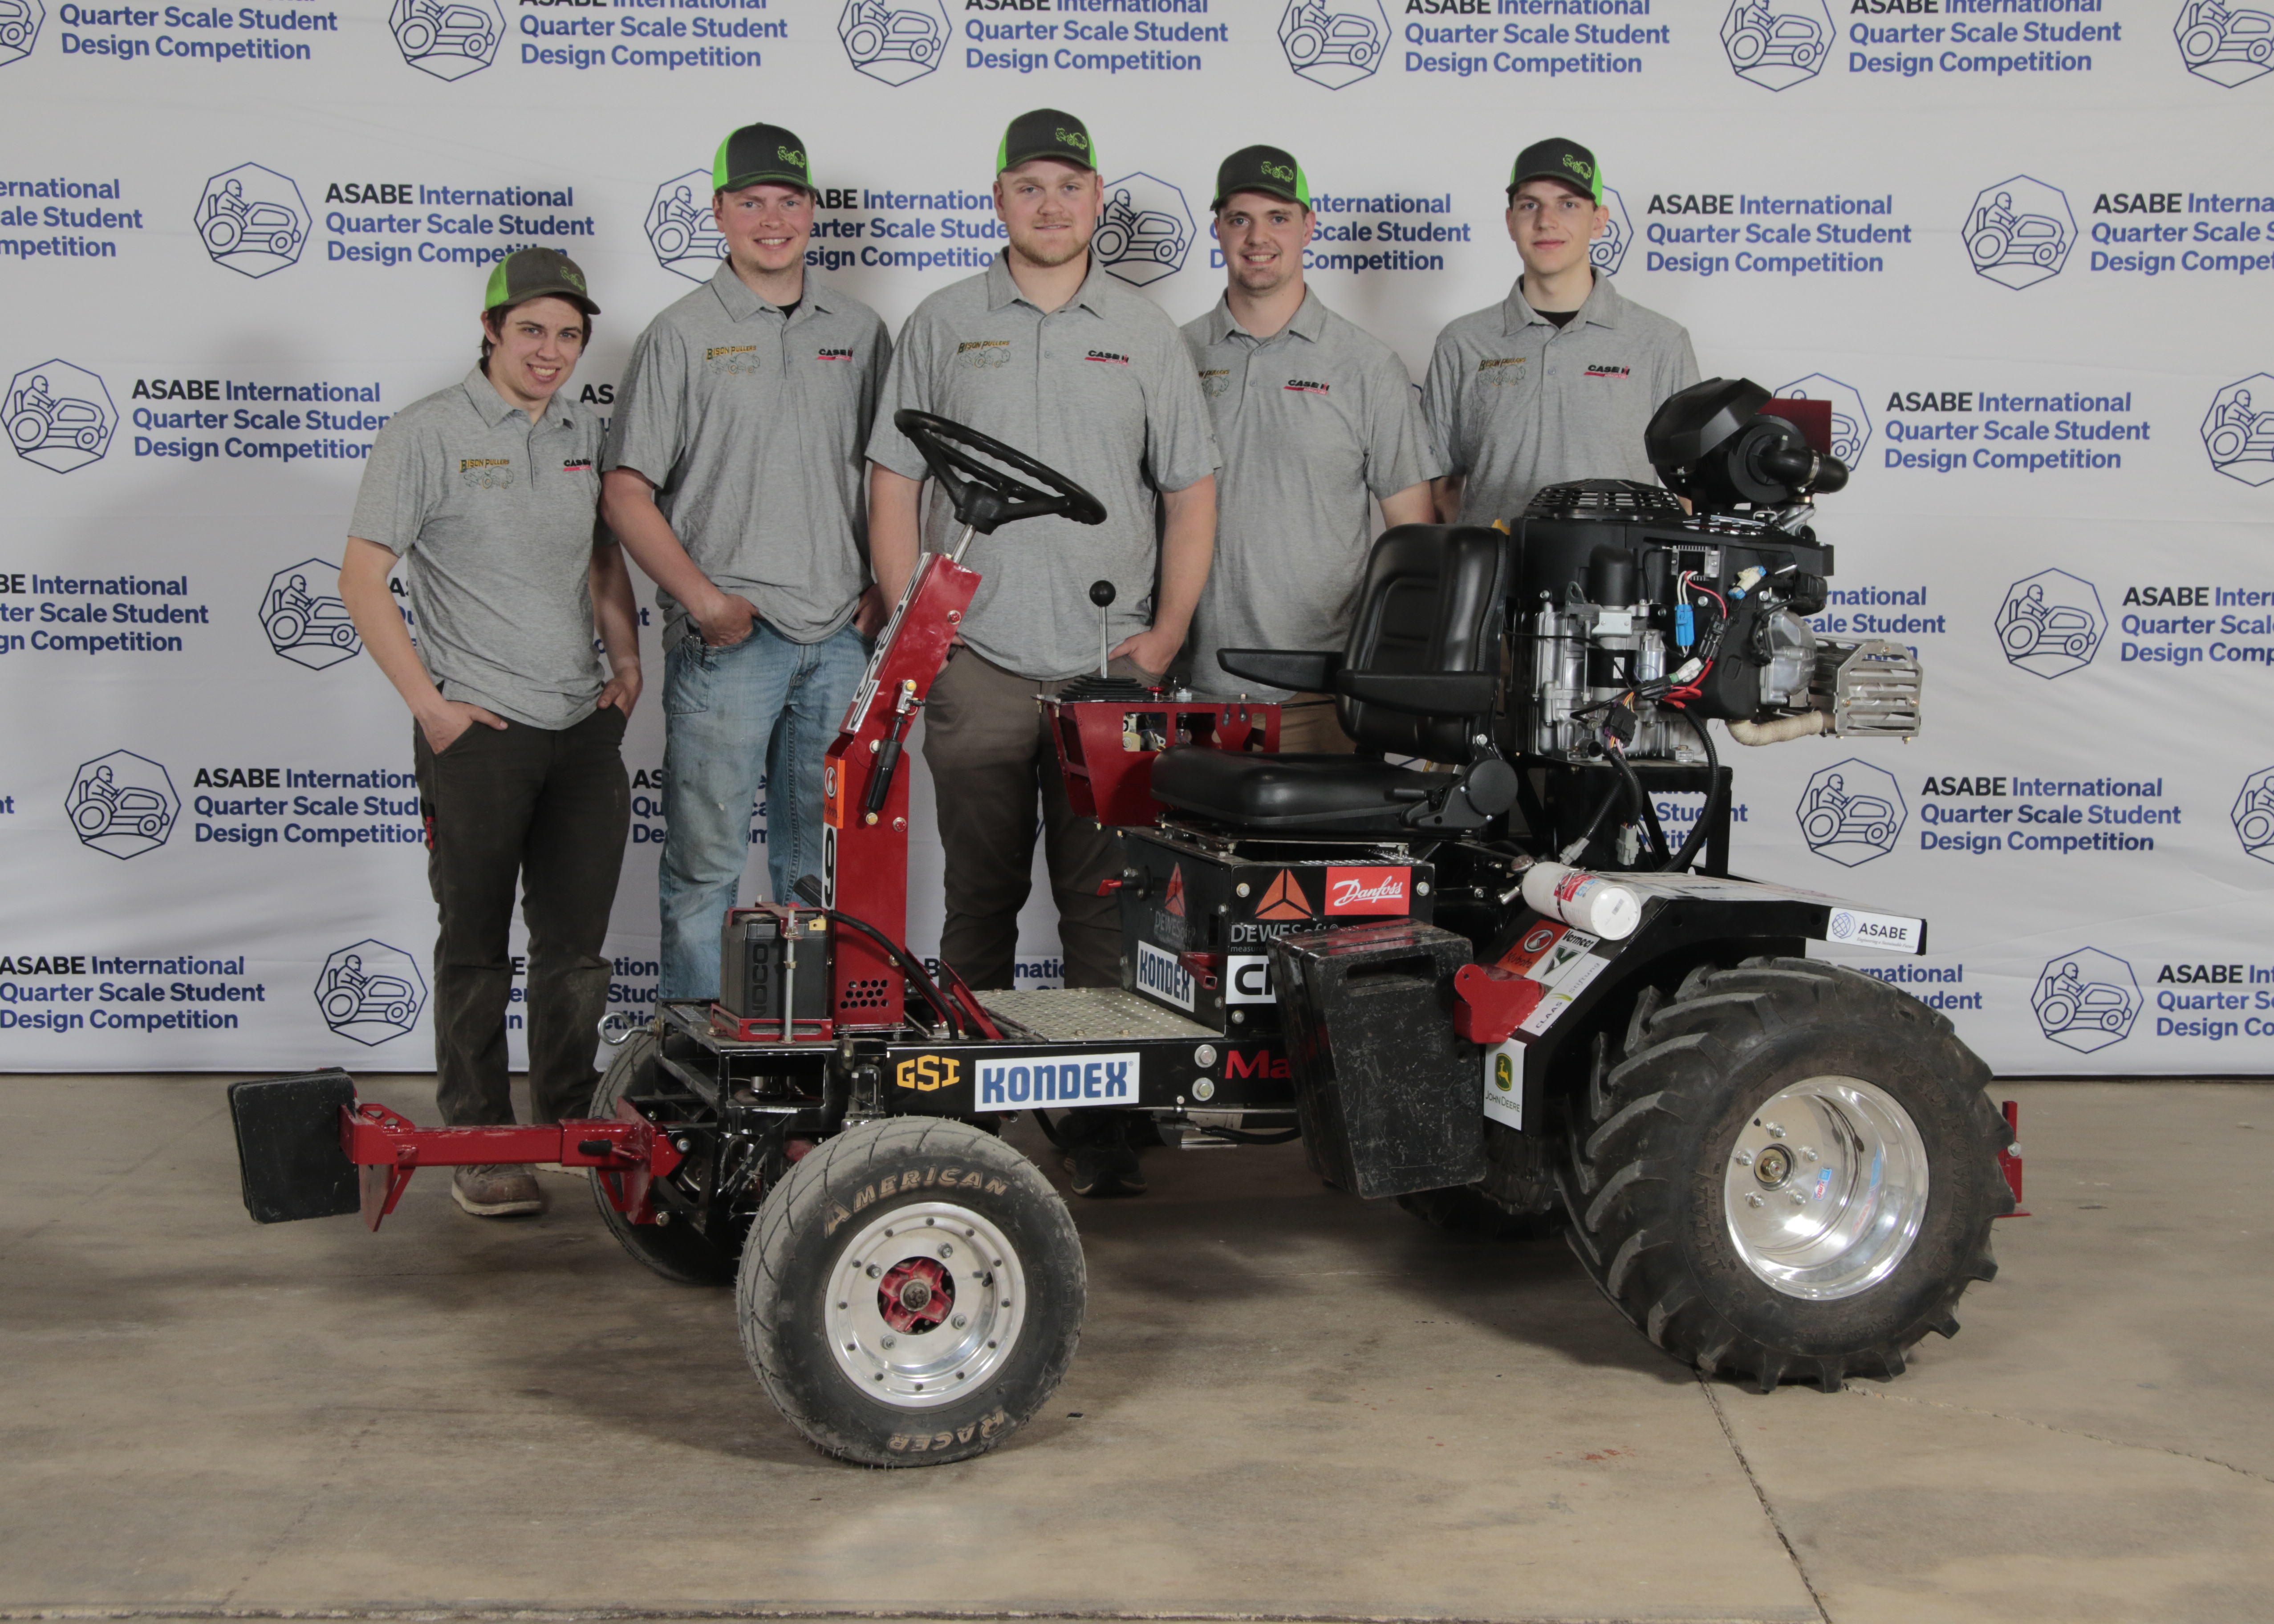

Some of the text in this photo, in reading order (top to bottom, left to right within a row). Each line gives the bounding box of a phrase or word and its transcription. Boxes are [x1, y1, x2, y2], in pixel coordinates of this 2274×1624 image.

[60, 4, 337, 31] Quarter Scale Student
[1405, 0, 1649, 15] ASABE International
[1850, 0, 2102, 14] ASABE International
[520, 14, 788, 38] Quarter Scale Student
[965, 19, 1228, 42] Quarter Scale Student
[1405, 23, 1670, 46] Quarter Scale Student
[1850, 21, 2122, 46] Quarter Scale Student
[61, 32, 310, 62] Design Competition
[521, 43, 761, 70] Design Competition
[966, 48, 1201, 74] Design Competition
[1405, 52, 1642, 77] Design Competition
[1849, 51, 2091, 77] Design Competition
[0, 177, 120, 199] ernational
[325, 183, 573, 207] ASABE International
[816, 188, 995, 210] ABE Internation
[1310, 193, 1451, 213] nternational
[1647, 194, 1892, 215] ASABE International
[2093, 193, 2274, 214] ASABE Interna
[0, 206, 143, 229] ale Student
[326, 212, 595, 235] Quarter Scale Student
[810, 217, 1008, 239] arter Scale Stude
[1312, 221, 1470, 242] Scale Student
[1647, 223, 1912, 246] Quarter Scale Student
[2091, 222, 2188, 245] Quarter
[2193, 221, 2261, 242] Scale
[0, 235, 116, 260] mpetition
[328, 240, 412, 267] Design
[804, 246, 855, 271] sign
[1303, 249, 1443, 274] Competition
[1647, 251, 1883, 276] Design Competition
[2091, 251, 2175, 276] Design
[706, 345, 756, 361] BISON PULLERS
[958, 340, 1010, 354] BISON PULLERS
[1088, 350, 1120, 360] CASE
[1588, 364, 1620, 373] CASE
[132, 379, 380, 402] ASABE International
[1288, 380, 1319, 389] CASE
[1886, 392, 2131, 412] ASABE International
[133, 407, 398, 431] Quarter Scale Studen
[1885, 420, 2150, 443] Quarter Scale Student
[134, 436, 372, 463] Design Competition
[1885, 448, 2121, 473] Design Competition
[459, 459, 509, 473] BISON PULLERS
[32, 574, 187, 596] International
[2122, 587, 2209, 606] ASABE
[40, 602, 107, 623] Scale
[112, 603, 209, 624] Student
[1802, 613, 1945, 633] cale Student
[2121, 614, 2216, 637] Quarter
[31, 630, 182, 655] Competition
[2121, 642, 2203, 666] Design
[194, 768, 416, 788] ASABE Internation
[1921, 776, 2162, 797] ASABE International
[194, 795, 418, 818] Quarter Scale Stud
[1921, 804, 2181, 826] Quarter Scale Student
[195, 823, 426, 848] Design Competition
[1921, 831, 2154, 855] Design Competition
[824, 827, 836, 907] 9
[1332, 875, 1403, 907] Danfoss
[1562, 930, 1594, 948] Vermeer
[1856, 937, 1878, 945] Engineering
[1858, 922, 1908, 940] ASABE
[0, 955, 244, 975] ASABE International
[1507, 952, 1533, 969] Kubota
[1139, 949, 1190, 1003] KONDEX
[2157, 964, 2243, 983] ASABE
[0, 982, 265, 1004] Quarter Scale Student
[1535, 962, 1600, 1029] CLAAS Stiftung
[2157, 991, 2250, 1012] Quarter
[0, 1009, 238, 1033] Design Competition
[2157, 1017, 2238, 1041] Design
[897, 1055, 960, 1092] GSI
[1225, 1051, 1290, 1079] Ma
[982, 1061, 1128, 1104] KONDEX
[1485, 1090, 1520, 1113] JOHN DEERE
[824, 1166, 1008, 1238] AMERICAN
[890, 1409, 1005, 1453] RACER
